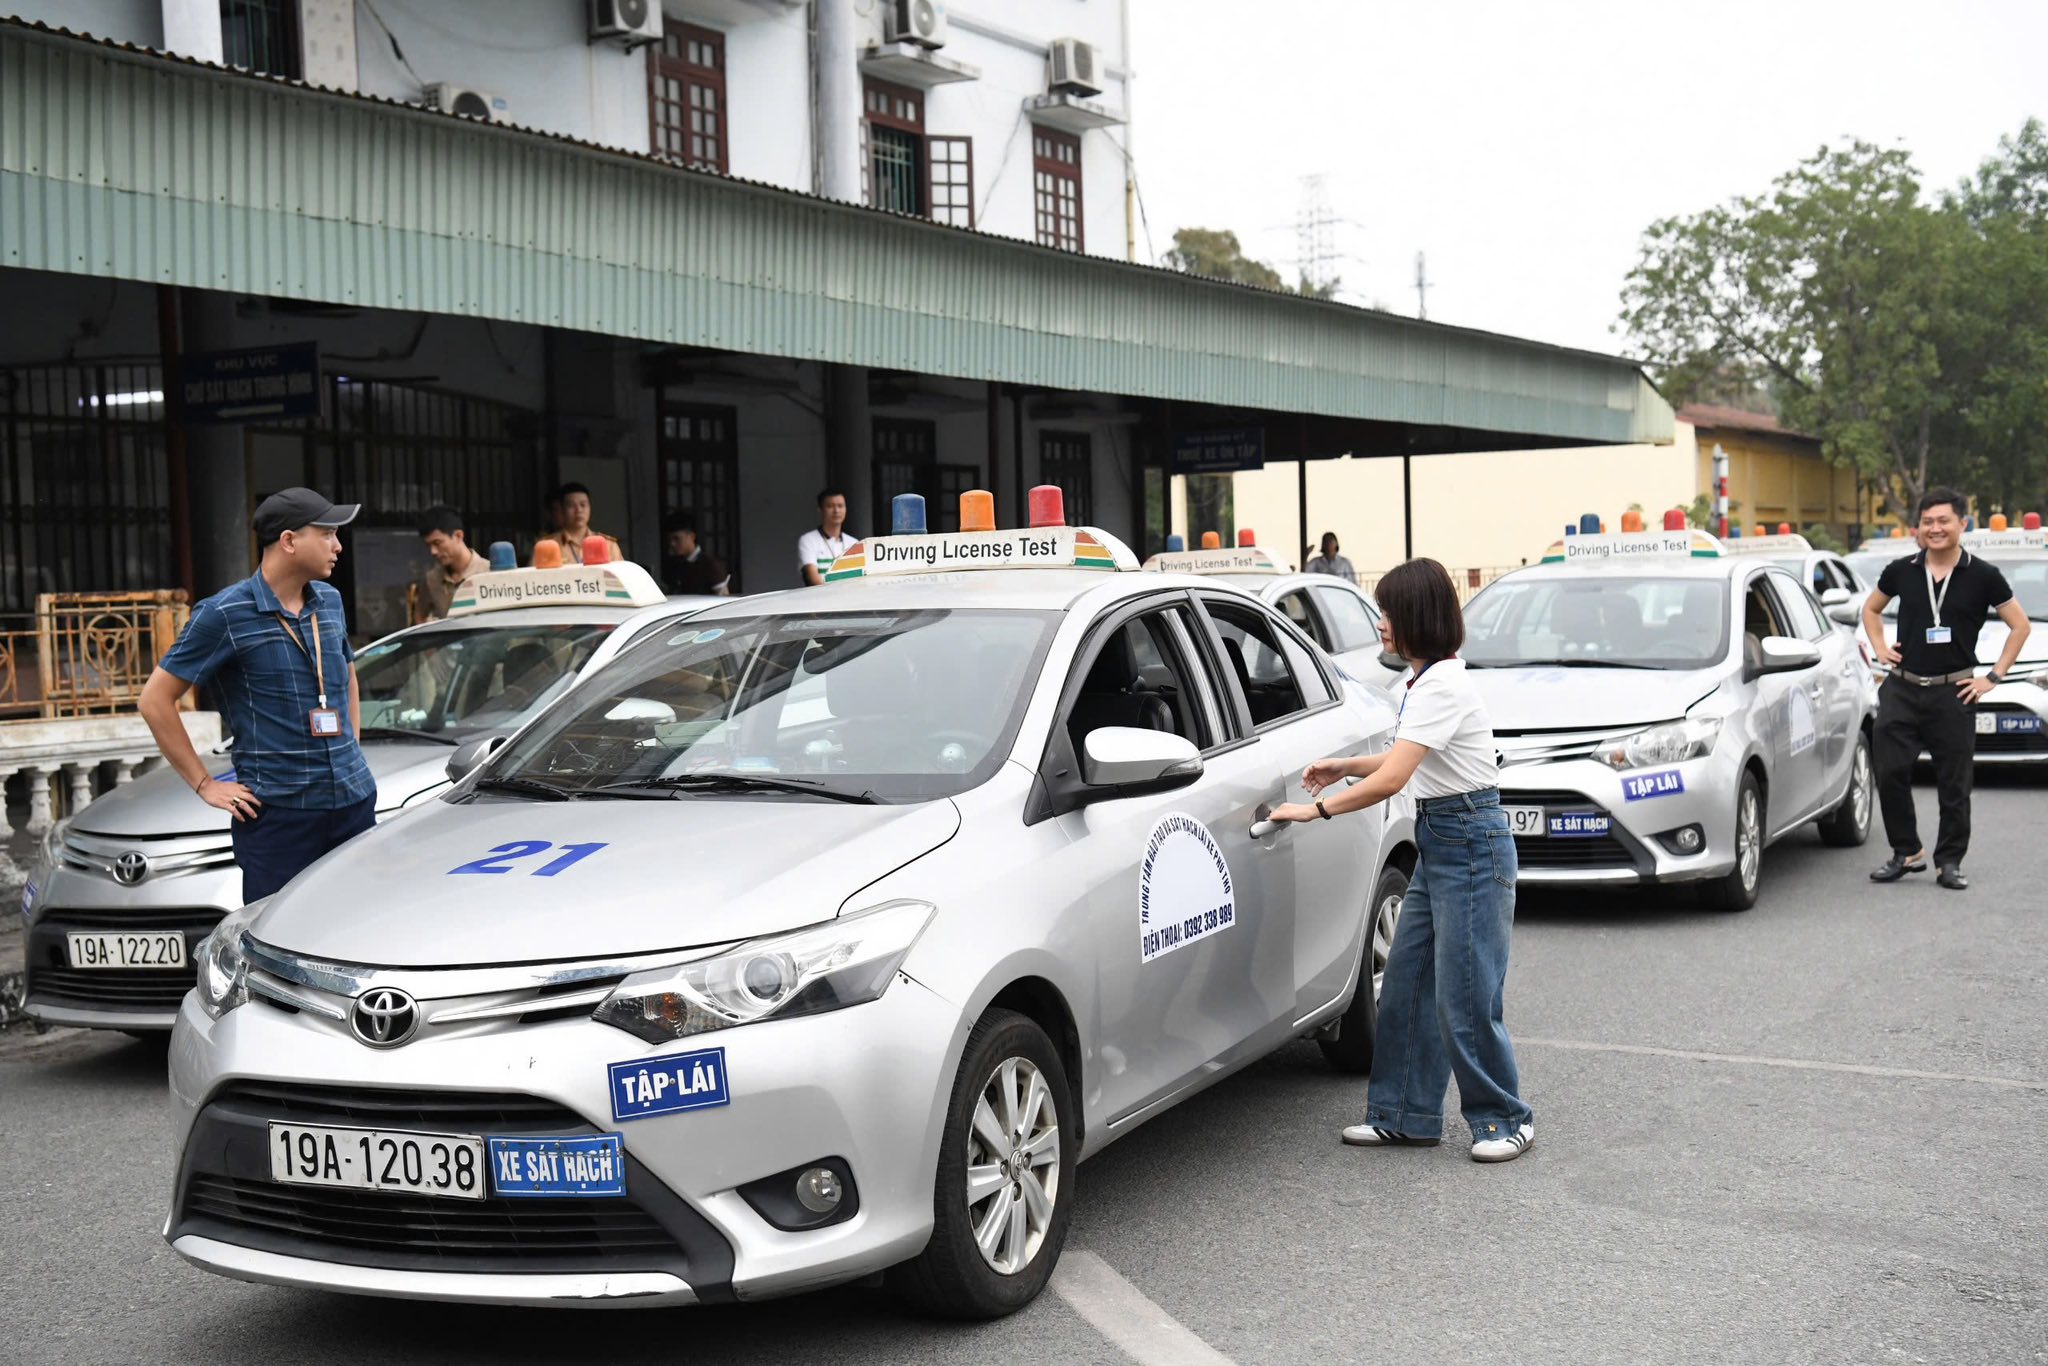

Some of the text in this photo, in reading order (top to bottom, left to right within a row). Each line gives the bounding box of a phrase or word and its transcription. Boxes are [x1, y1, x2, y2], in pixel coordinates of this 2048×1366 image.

[874, 537, 1057, 564] Driving License Test
[1568, 540, 1687, 557] Driving License Test
[1161, 557, 1252, 572] Driving License Test
[479, 579, 600, 600] Driving License Test
[1628, 774, 1678, 797] TẬP LÁI
[1551, 815, 1608, 833] XE SÁT HẠCH
[446, 840, 610, 876] 21
[1142, 885, 1150, 924] TRUNG
[1143, 903, 1232, 958] ĐIỆN THOẠI: 0392 338 989
[621, 1060, 716, 1107] TẬP LÁI
[280, 1130, 475, 1190] 19A-120.38
[498, 1144, 613, 1188] XE SÁT HẠCH
